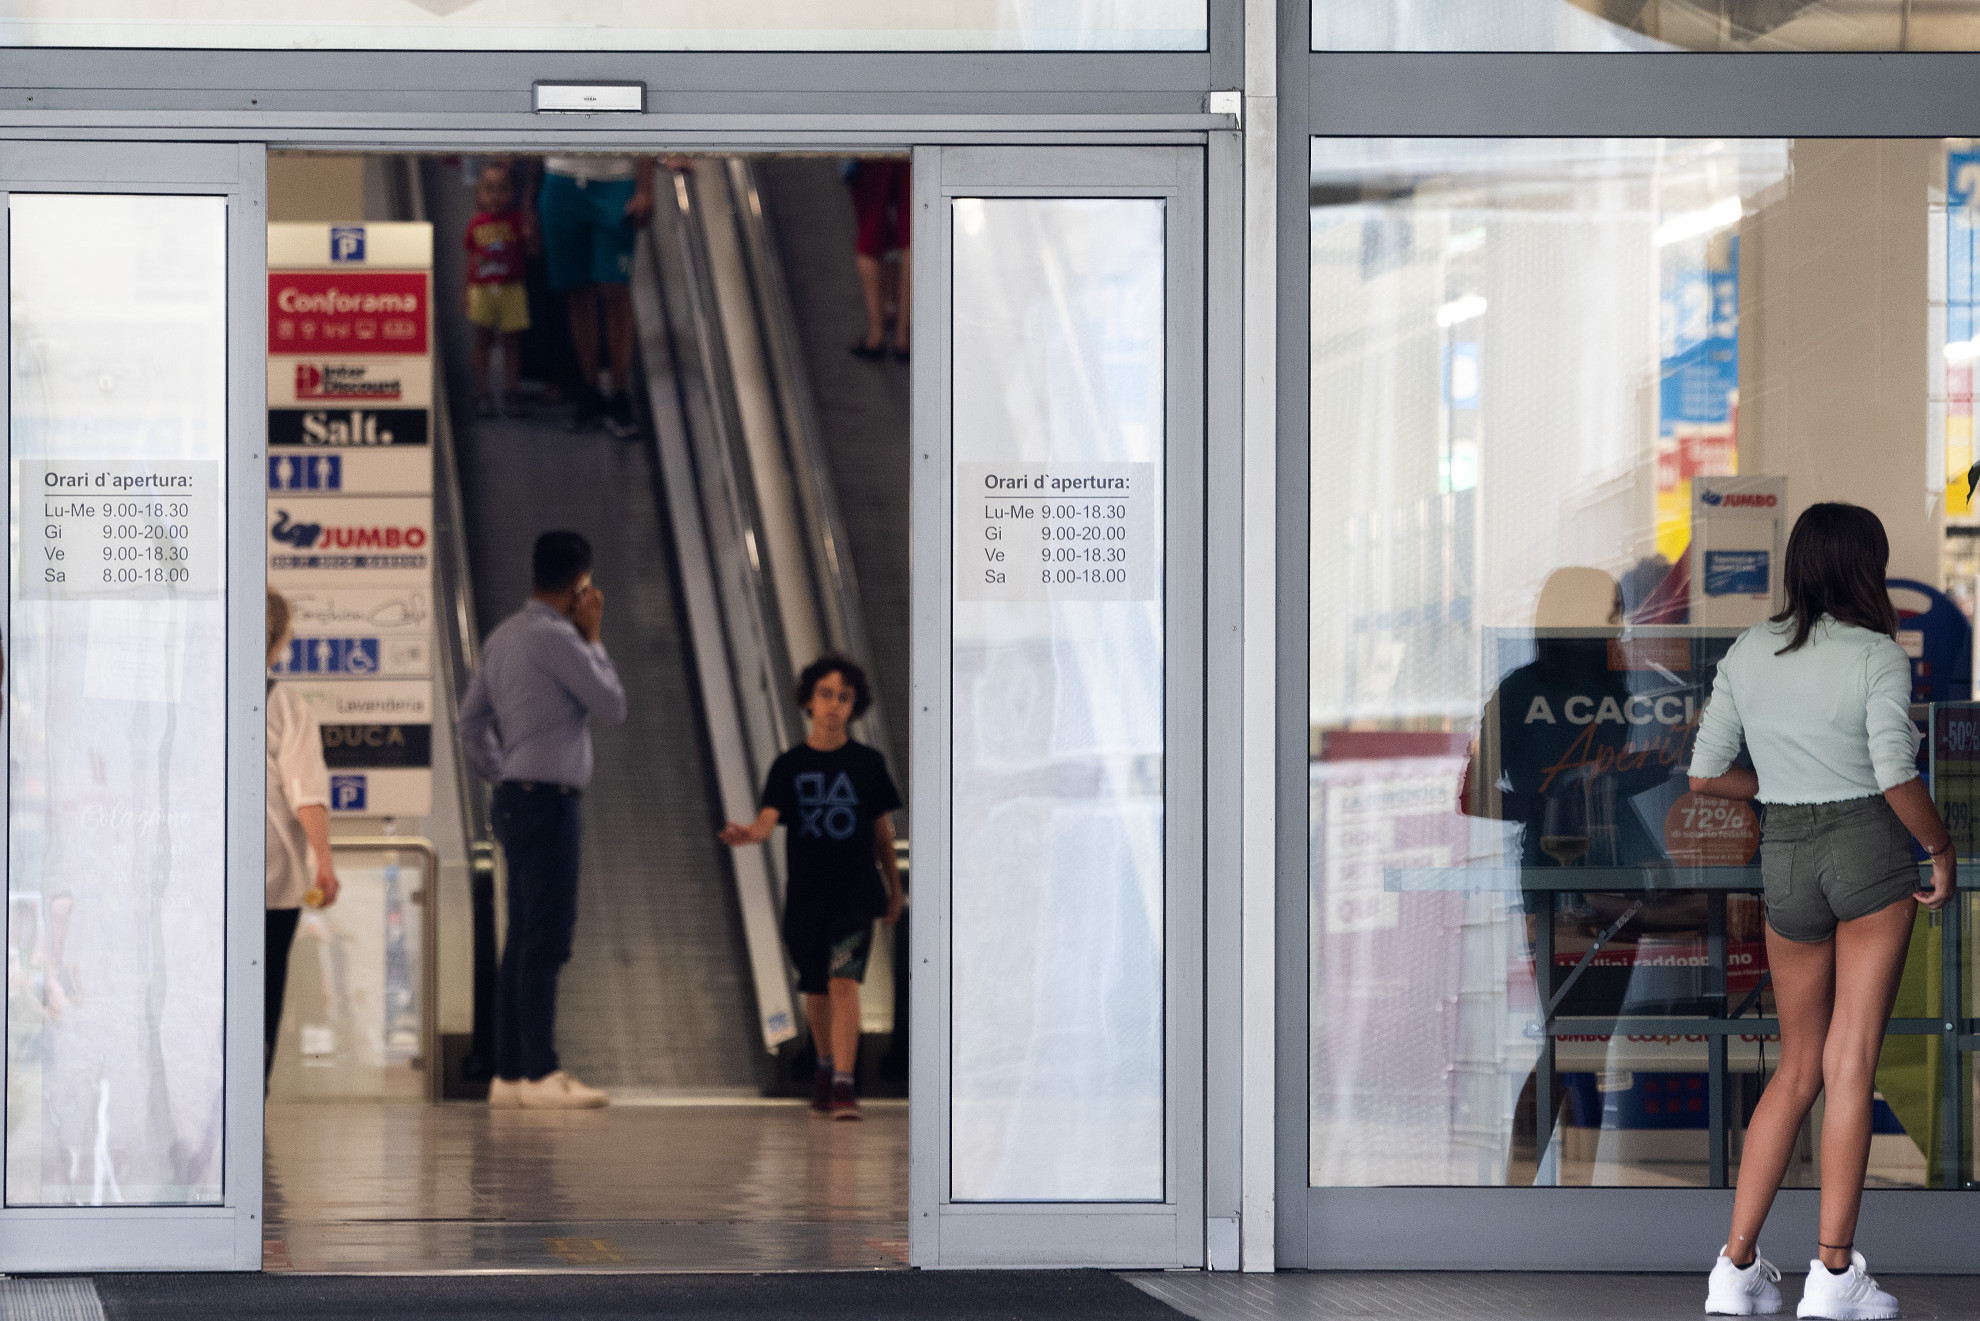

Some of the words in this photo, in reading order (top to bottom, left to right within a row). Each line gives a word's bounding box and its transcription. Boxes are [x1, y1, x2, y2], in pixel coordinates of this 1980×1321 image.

[278, 287, 417, 315] Conforama
[303, 411, 394, 445] Salt.
[44, 472, 88, 487] Orari
[985, 475, 1028, 489] Orari
[1722, 494, 1778, 507] JUMBO
[44, 503, 95, 517] Lu-Me
[103, 503, 189, 517] 9.00-18.30
[985, 505, 1034, 519] Lu-Me
[1042, 505, 1126, 519] 9.00-18.30
[44, 525, 62, 539] Gi
[103, 525, 189, 539] 9.00-20.00
[318, 527, 426, 549] JUMBO
[985, 526, 1002, 540] Gi
[1042, 526, 1126, 540] 9.00-20.00
[44, 546, 65, 560] Ve
[103, 546, 189, 560] 9.00-18.30
[985, 548, 1005, 562] Ve
[1042, 548, 1126, 562] 9.00-18.30
[44, 568, 66, 582] Sa
[103, 568, 189, 582] 8.00-18.00
[985, 569, 1006, 583] Sa
[1042, 569, 1126, 583] 8.00-18.00
[1524, 696, 1557, 724] A
[1681, 807, 1744, 829] 72%
